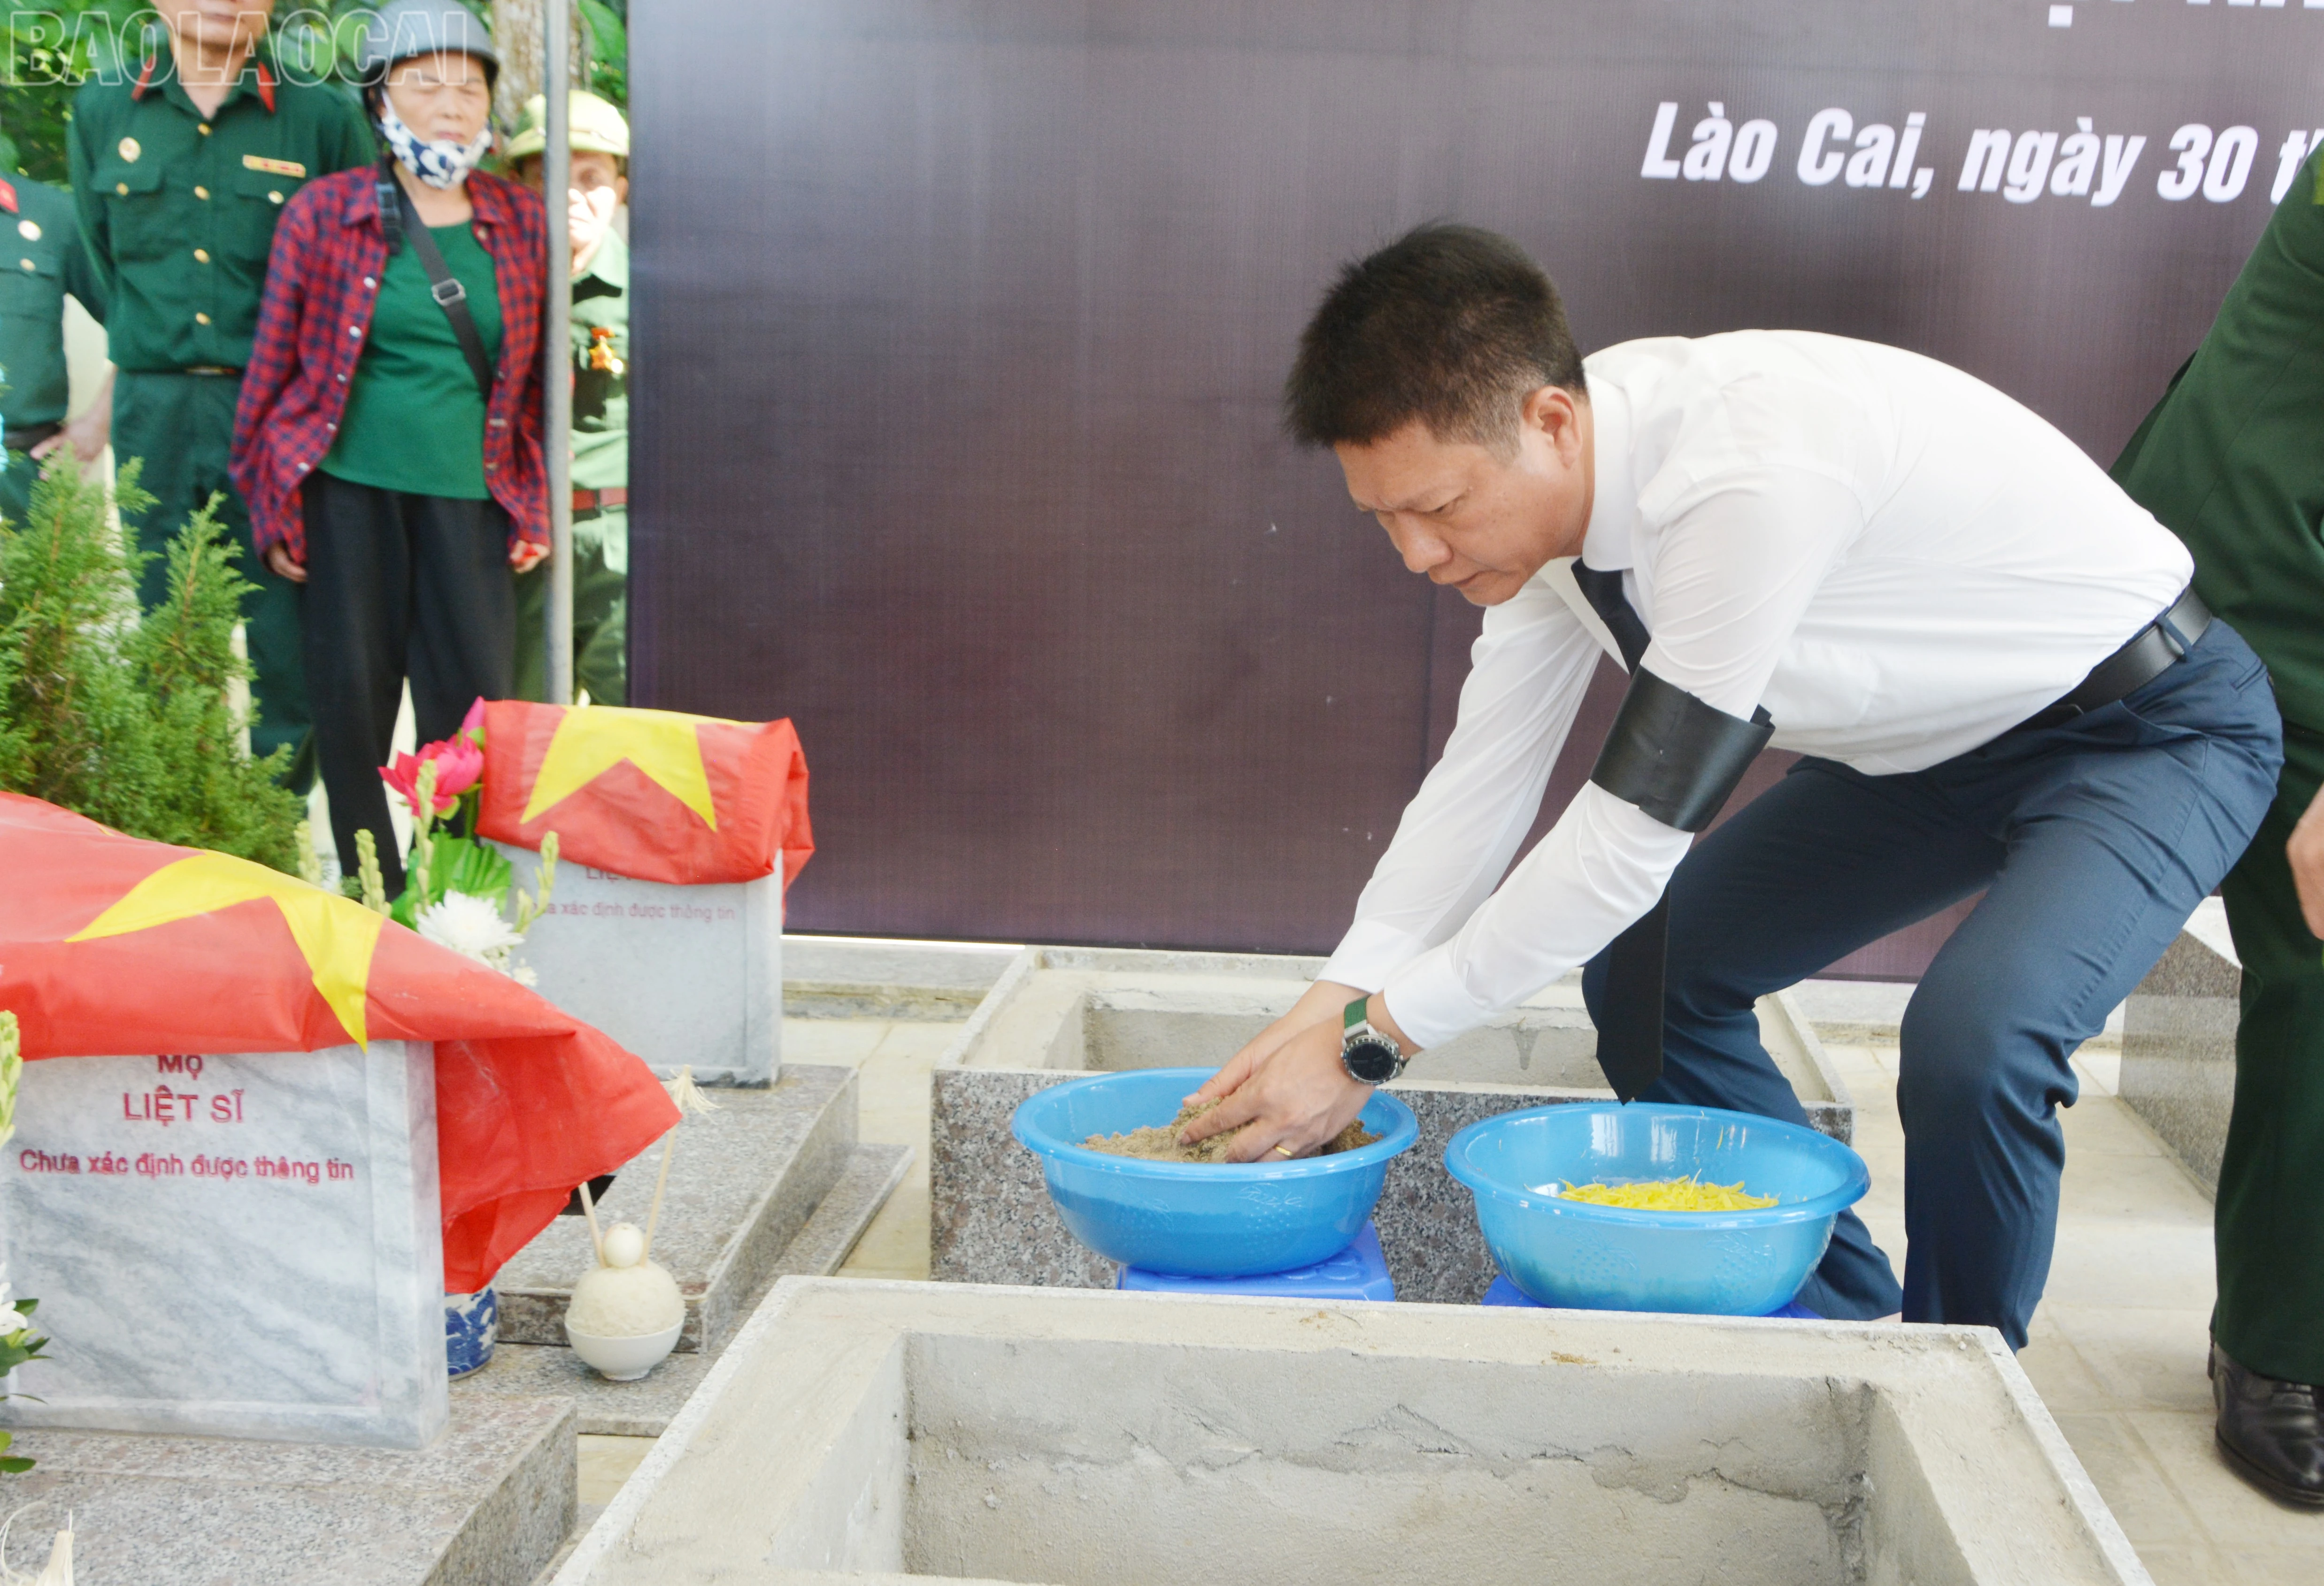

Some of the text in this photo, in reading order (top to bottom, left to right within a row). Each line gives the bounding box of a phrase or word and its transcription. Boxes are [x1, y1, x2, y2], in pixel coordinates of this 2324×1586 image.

[1639, 101, 1778, 183] Lào
[1796, 107, 1935, 199] Cai,
[1958, 116, 2147, 206] ngày
[2156, 123, 2259, 202] 30
[123, 1084, 245, 1127] LIỆT SĨ
[20, 1148, 80, 1174] Chưa
[87, 1150, 129, 1175] xác
[136, 1152, 185, 1180] định
[191, 1153, 248, 1182] được
[326, 1156, 354, 1181] tin
